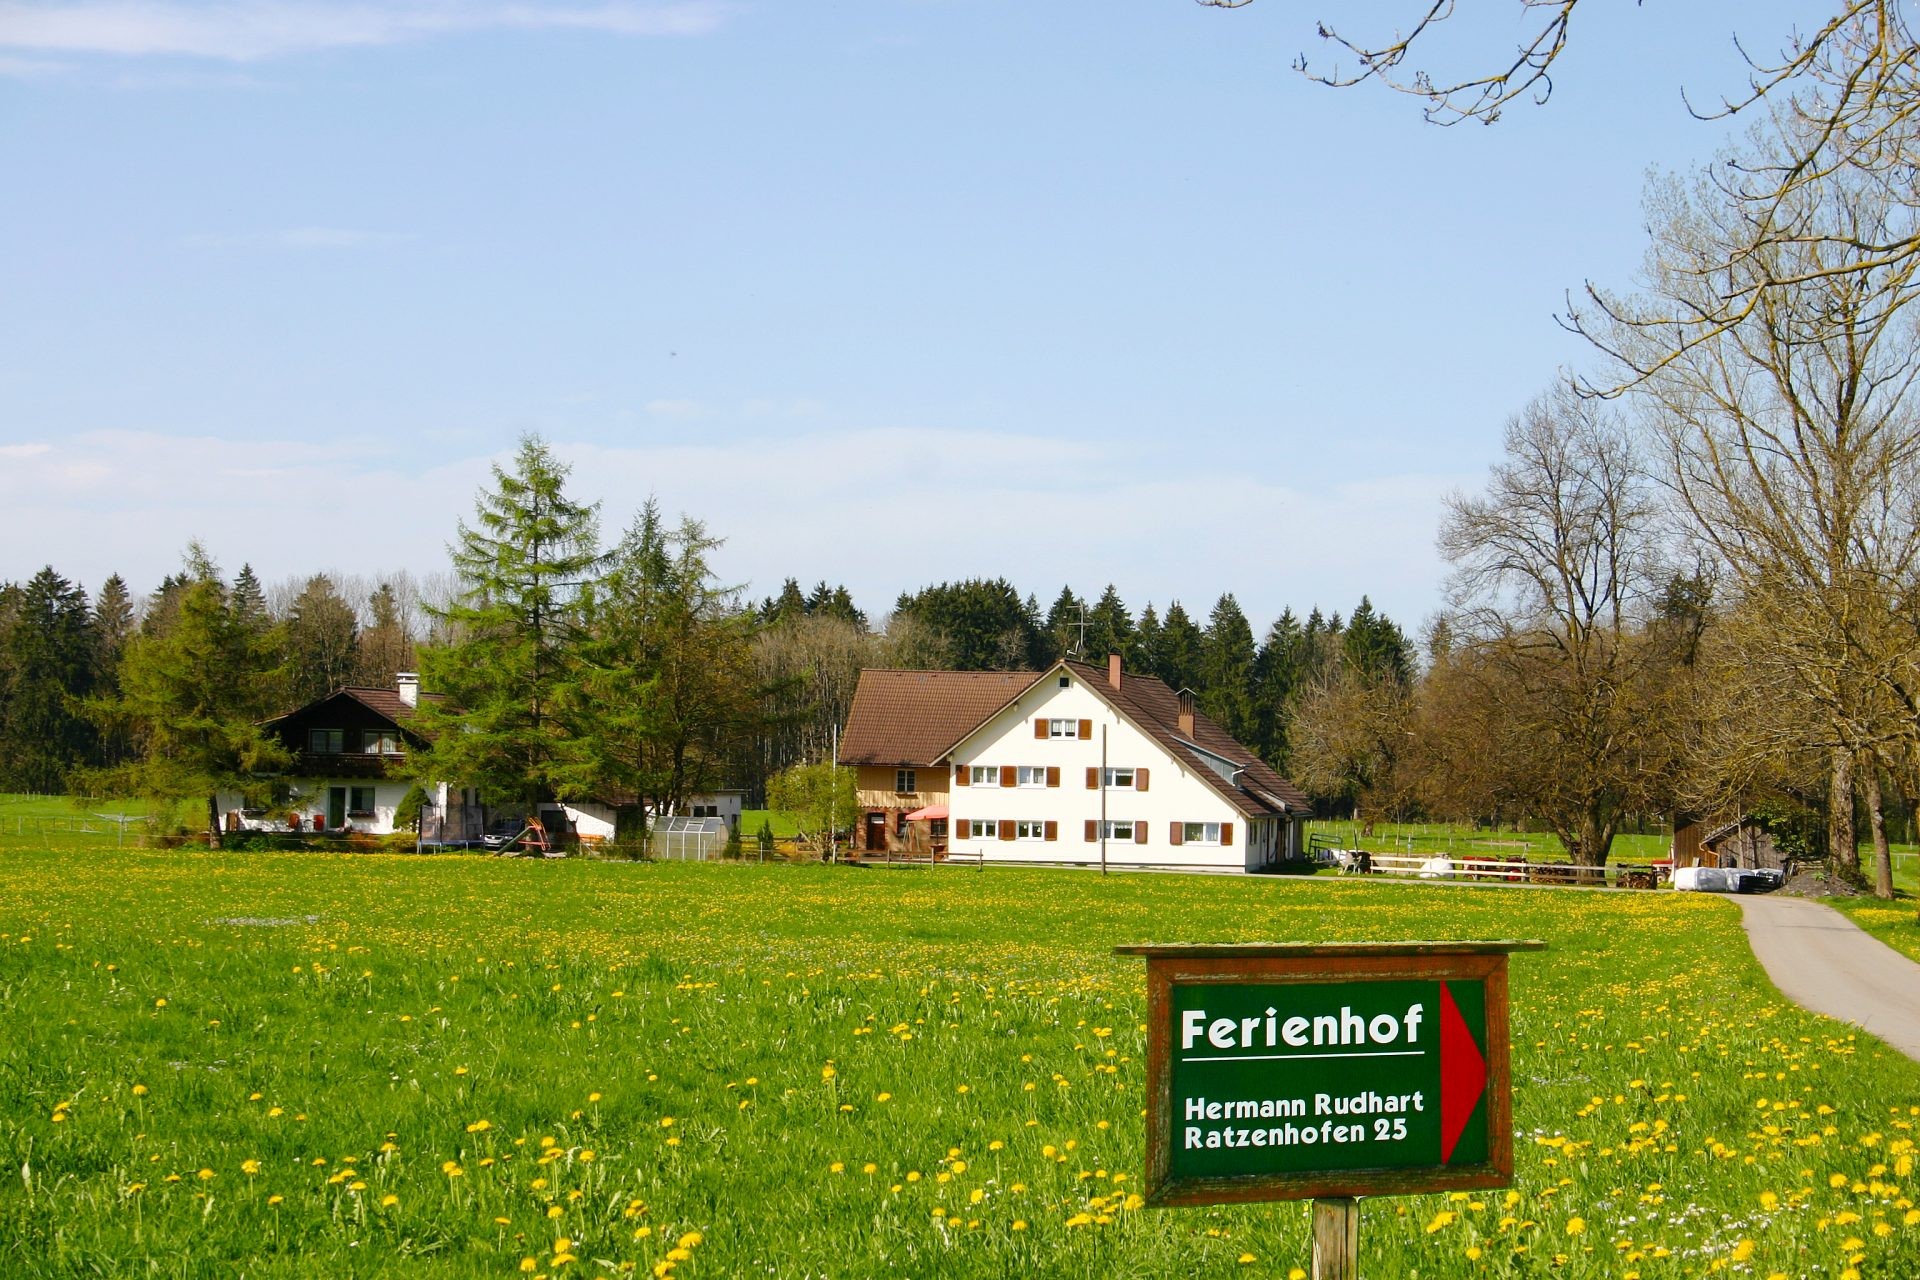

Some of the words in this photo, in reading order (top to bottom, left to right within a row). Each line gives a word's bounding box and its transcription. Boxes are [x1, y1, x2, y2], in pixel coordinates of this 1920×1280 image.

[1181, 1003, 1424, 1050] Ferienhof
[1184, 1097, 1306, 1121] Hermann
[1314, 1090, 1424, 1116] Rudhart
[1184, 1120, 1365, 1150] Ratzenhofen
[1373, 1118, 1407, 1142] 25
